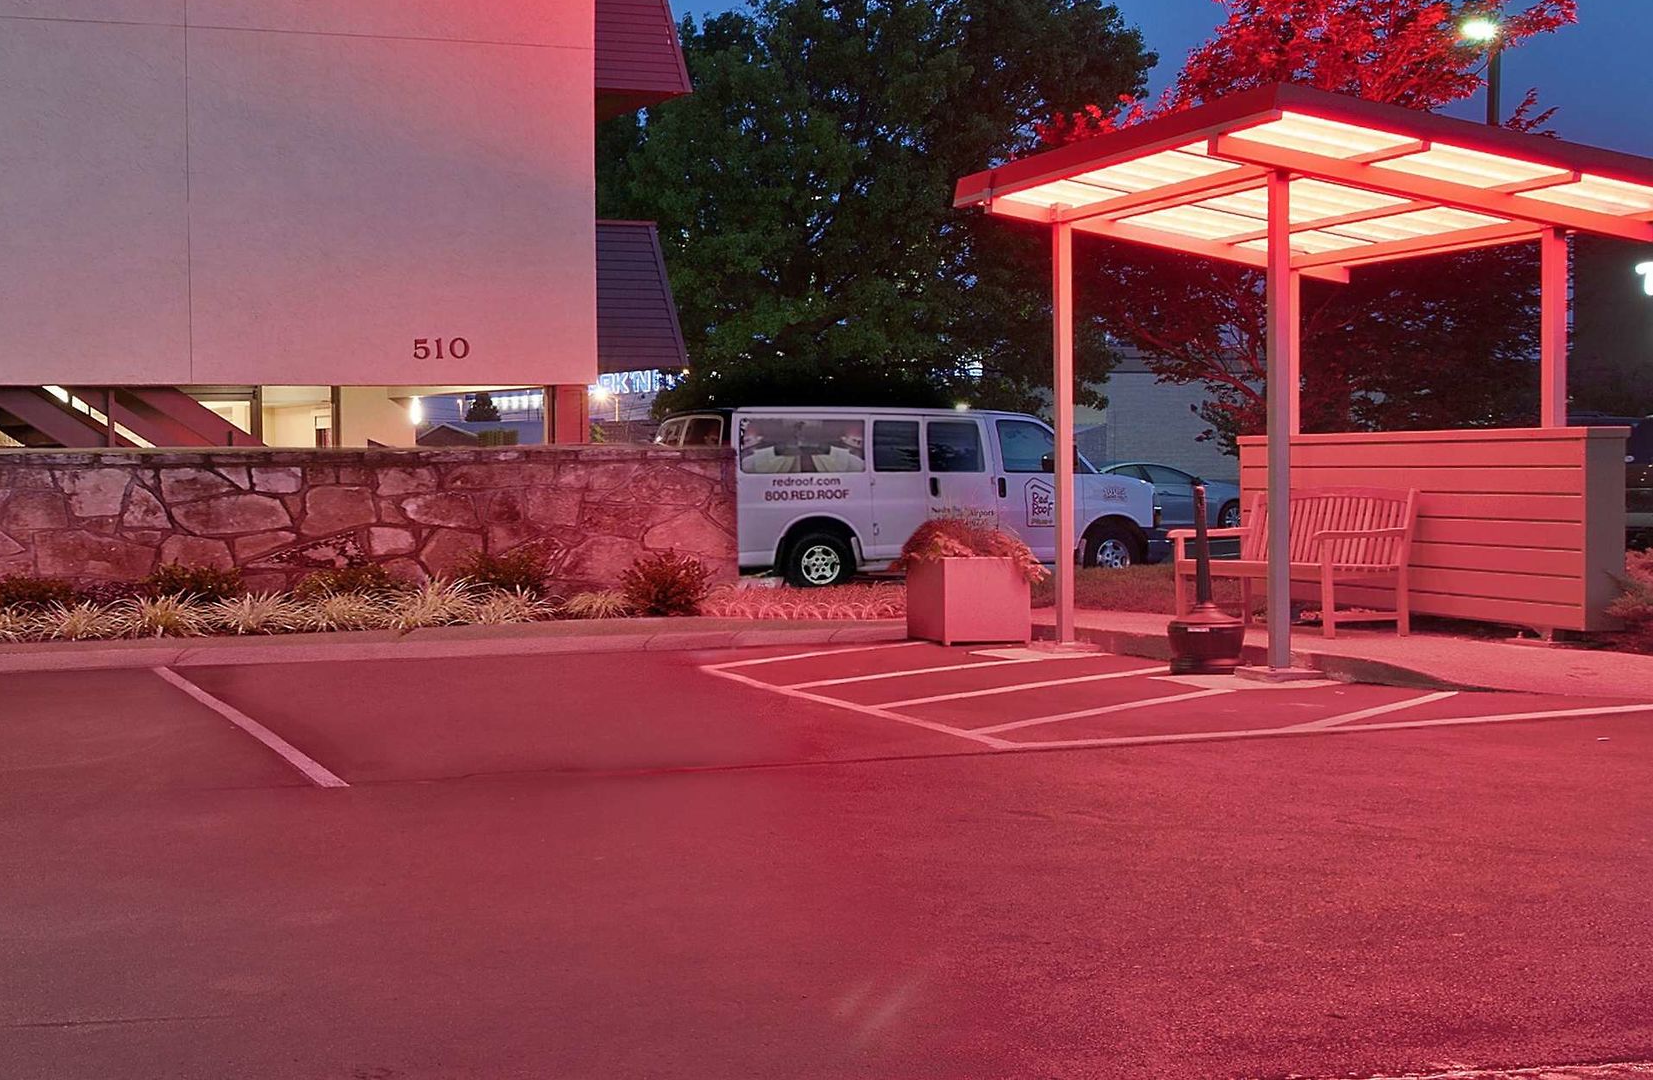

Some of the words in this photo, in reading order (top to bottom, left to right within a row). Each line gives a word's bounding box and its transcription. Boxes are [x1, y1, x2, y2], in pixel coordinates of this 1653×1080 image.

[413, 337, 470, 360] 510
[772, 477, 841, 487] redroof.com
[1032, 492, 1049, 504] Red
[1032, 503, 1054, 516] Roof
